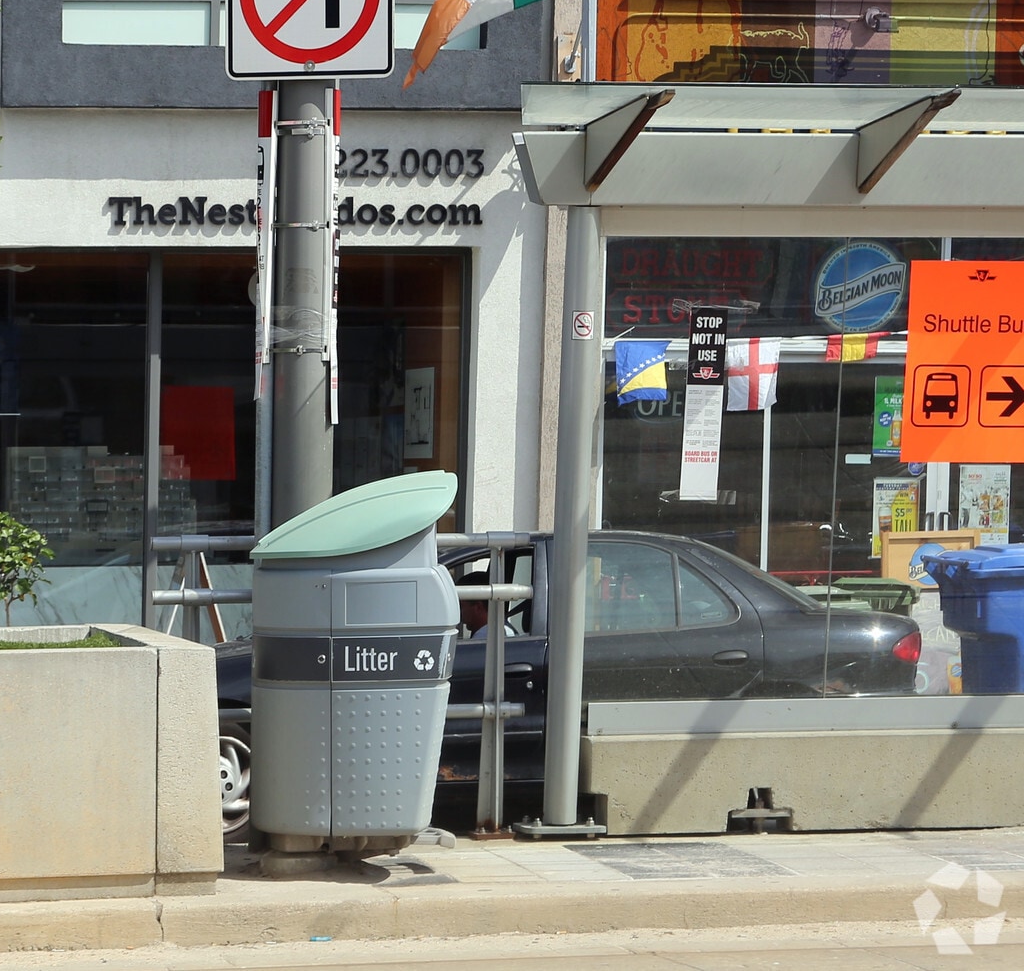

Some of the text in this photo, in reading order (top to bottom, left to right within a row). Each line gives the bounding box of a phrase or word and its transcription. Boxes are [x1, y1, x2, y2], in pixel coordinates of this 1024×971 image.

[621, 248, 765, 277] DRAUGHT
[818, 270, 902, 311] BELGIAN MOON
[696, 316, 723, 328] STOP
[923, 314, 1024, 333] Shuttle Bu
[692, 333, 725, 345] NOT IN
[697, 349, 718, 361] USE
[344, 646, 398, 672] Litter
